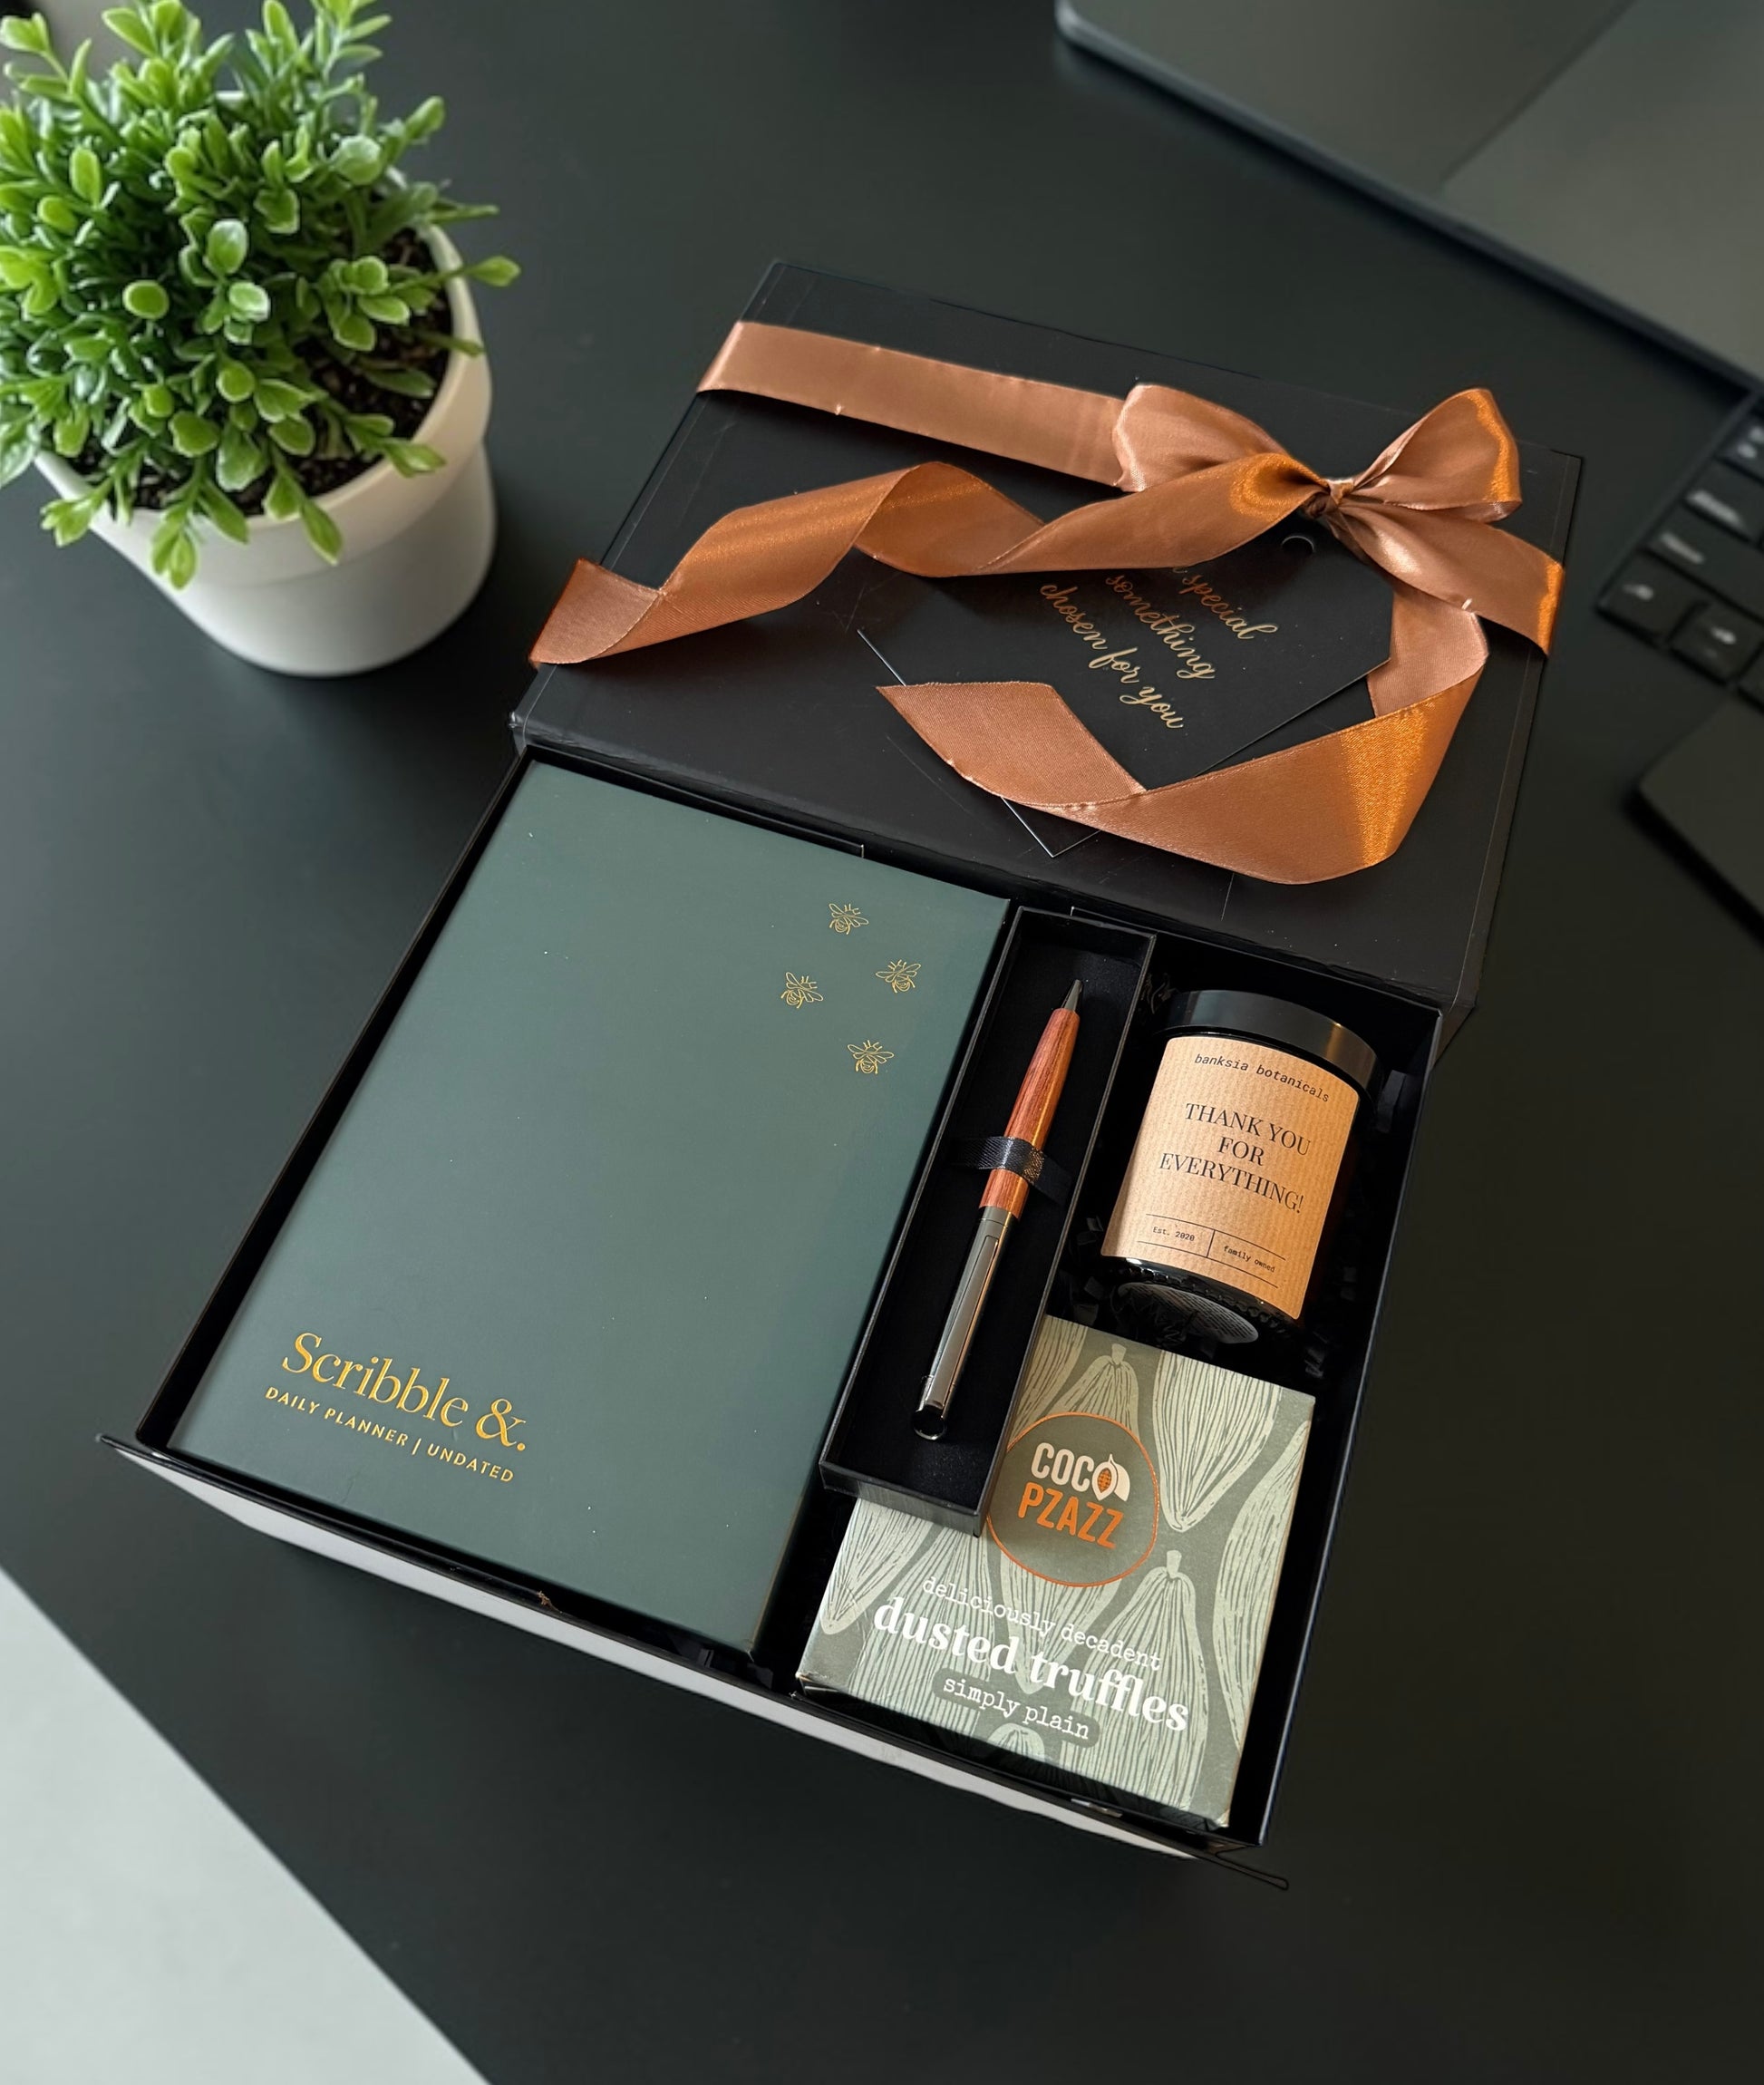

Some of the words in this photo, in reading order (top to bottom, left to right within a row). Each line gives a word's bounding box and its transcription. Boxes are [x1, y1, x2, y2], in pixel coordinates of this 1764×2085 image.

[1105, 575, 1215, 679] something
[1179, 575, 1277, 639] special
[1040, 584, 1108, 649] chosen
[1089, 647, 1139, 683] for
[1119, 686, 1183, 728] you
[1194, 1053, 1248, 1071] banksia
[1255, 1064, 1329, 1101] botanicals
[1185, 1102, 1264, 1136] THANK
[1268, 1123, 1311, 1155] YOU
[1216, 1137, 1265, 1165] FOR
[1158, 1153, 1304, 1212] EVERYTHING!
[1175, 1231, 1195, 1241] 2020
[1224, 1246, 1250, 1261] family
[1254, 1259, 1275, 1272] owned
[282, 1333, 468, 1426] Scribble
[265, 1386, 319, 1413] DAILY
[324, 1408, 408, 1446] PLANNER
[427, 1443, 513, 1481] UNDATED
[1031, 1442, 1129, 1501] COCO
[1017, 1482, 1124, 1548] PZAZZ
[923, 1576, 1056, 1634] deliciously
[1061, 1624, 1161, 1670] decadent
[873, 1596, 1019, 1673] dusted
[1030, 1650, 1189, 1731] truffles
[943, 1676, 1020, 1718] simply
[1023, 1706, 1089, 1740] plain
